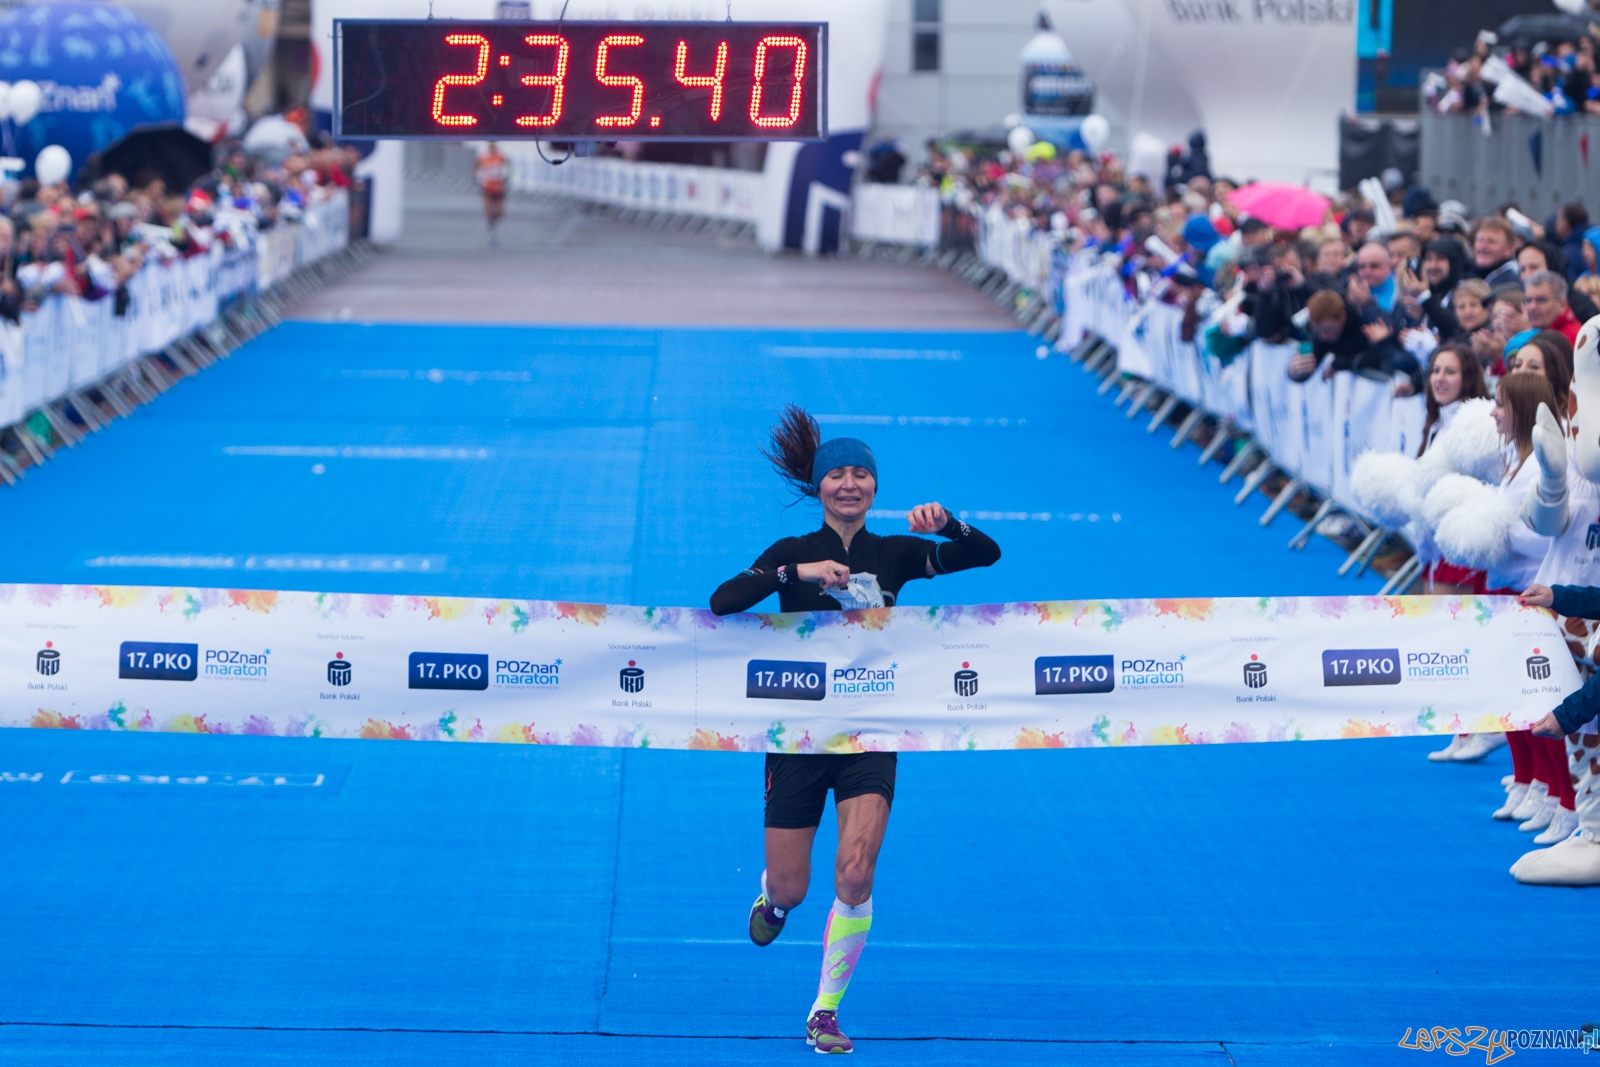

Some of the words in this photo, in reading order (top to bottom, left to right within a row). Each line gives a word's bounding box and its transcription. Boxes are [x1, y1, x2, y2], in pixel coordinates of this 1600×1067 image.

[432, 34, 808, 127] 2:35.40
[127, 652, 150, 669] 17.
[153, 652, 192, 670] PKO
[1330, 659, 1354, 675] 17.
[1356, 658, 1394, 675] PKO
[205, 663, 267, 676] maraton
[416, 663, 439, 679] 17.
[443, 664, 482, 680] PKO
[1042, 667, 1066, 683] 17.
[1069, 665, 1108, 682] PKO
[1408, 664, 1469, 676] maraton
[496, 673, 559, 685] maraton
[755, 671, 778, 687] 17.
[782, 671, 820, 689] PKO
[1122, 671, 1184, 685] maraton
[27, 682, 45, 690] Bank
[47, 682, 68, 691] Polski
[833, 680, 895, 693] maraton
[1521, 687, 1539, 695] Bank
[1541, 685, 1562, 693] Polski
[319, 692, 337, 700] Bank
[339, 693, 360, 701] Polski
[1236, 695, 1254, 703] Bank
[611, 699, 629, 707] Bank
[632, 700, 652, 708] Polski
[947, 703, 965, 711] Bank
[967, 703, 987, 711] Polski
